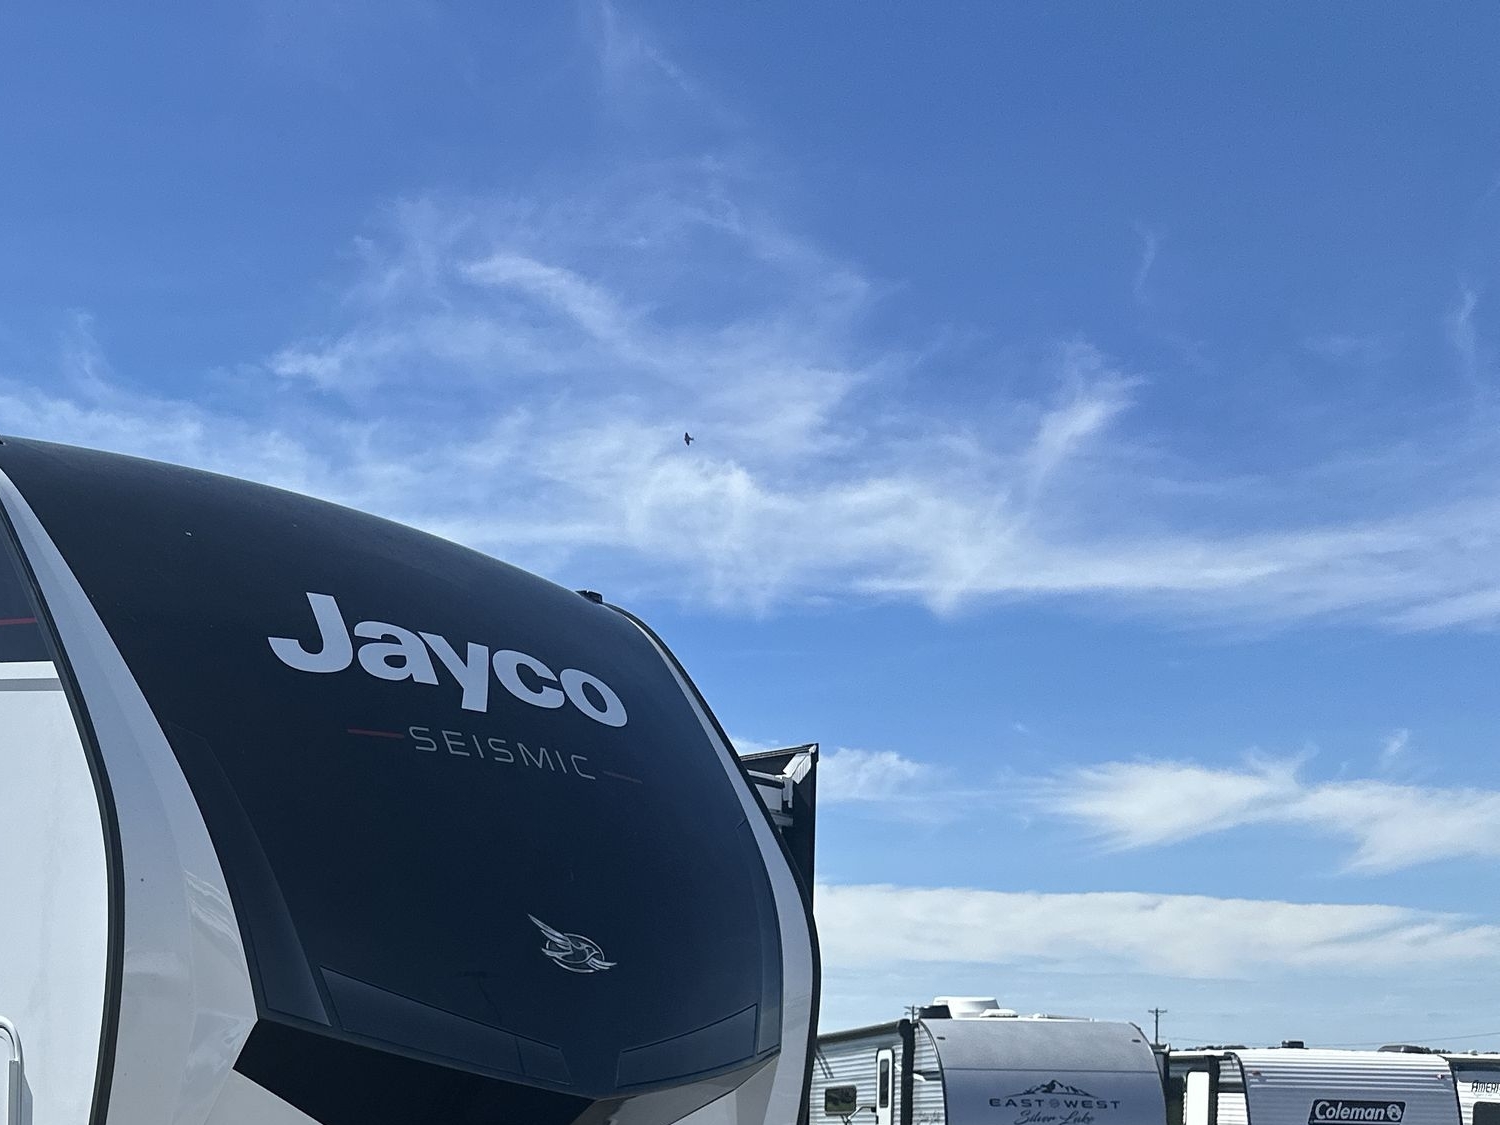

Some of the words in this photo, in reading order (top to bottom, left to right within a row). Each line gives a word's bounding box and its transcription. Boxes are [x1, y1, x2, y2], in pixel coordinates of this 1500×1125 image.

[267, 592, 628, 728] Jayco
[408, 726, 596, 781] SEISMIC
[1471, 1080, 1500, 1093] AMERI
[989, 1098, 1045, 1108] EAST
[1064, 1099, 1120, 1110] WEST
[1315, 1101, 1385, 1121] Coleman
[1013, 1109, 1055, 1125] Silver
